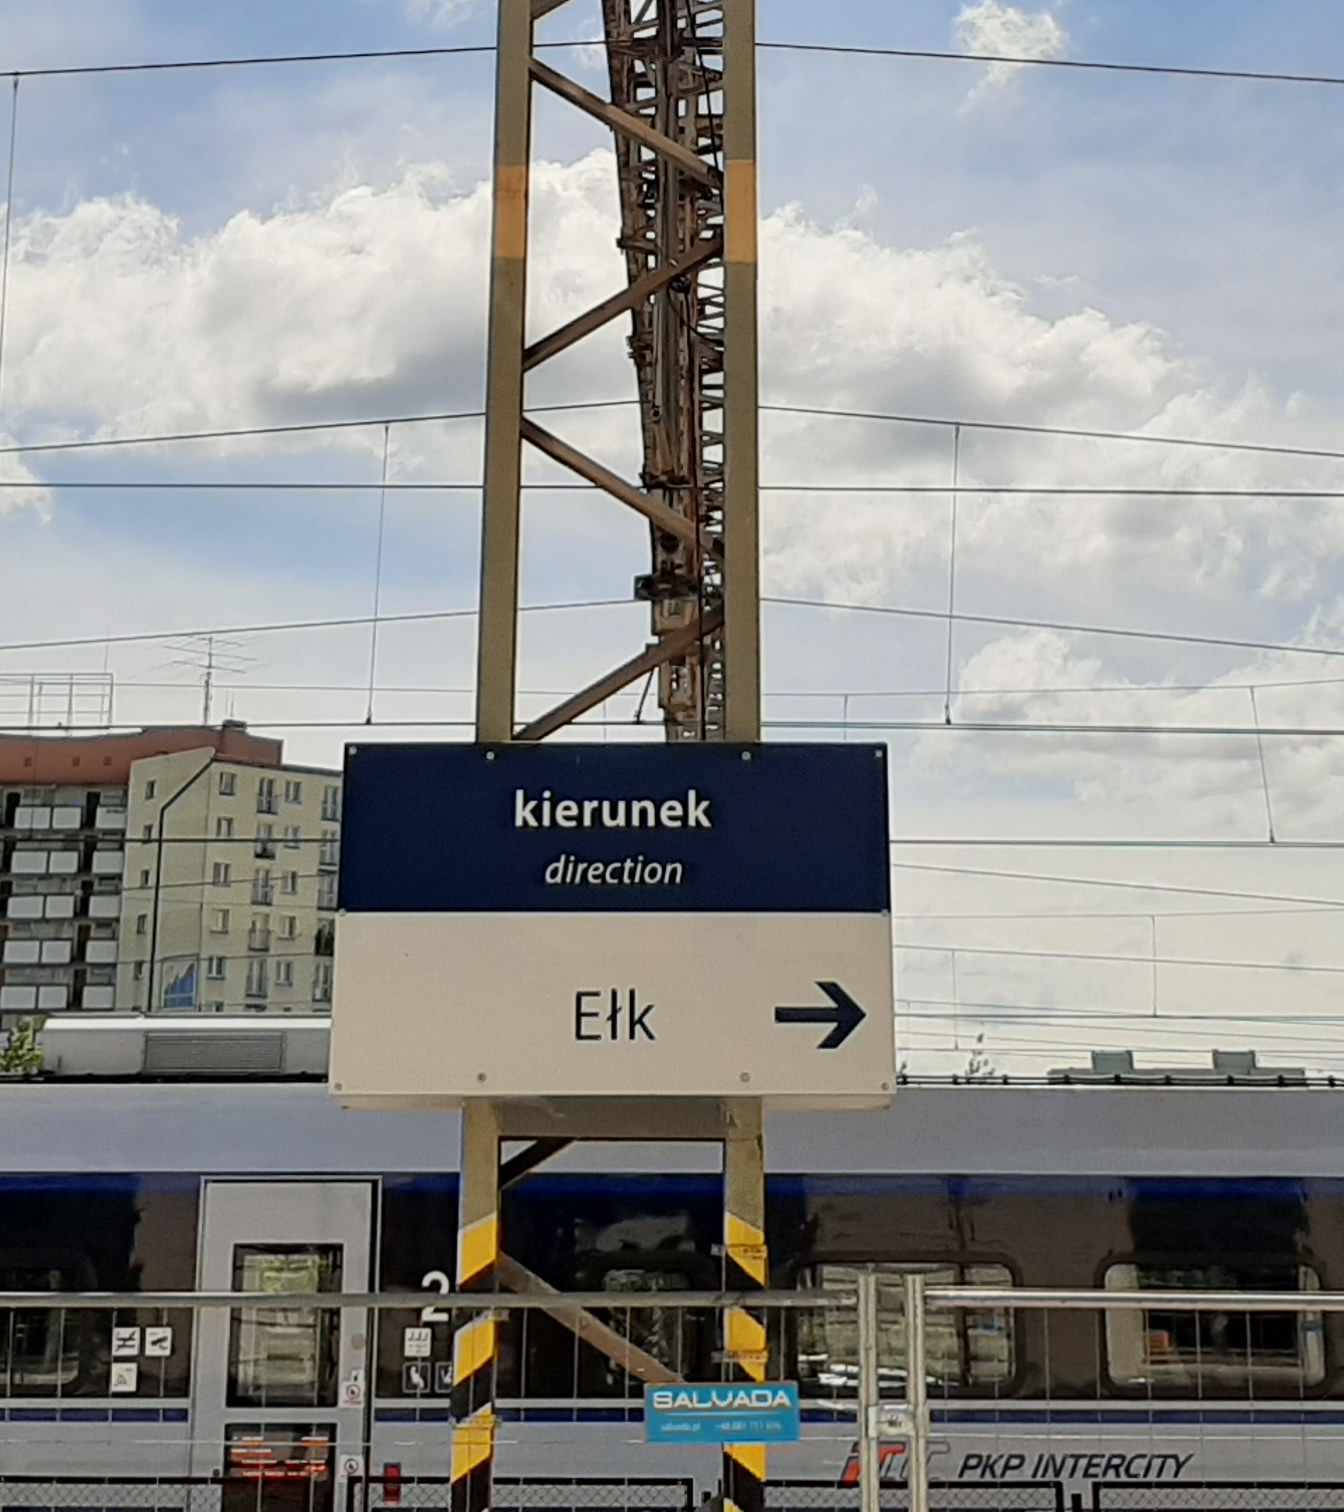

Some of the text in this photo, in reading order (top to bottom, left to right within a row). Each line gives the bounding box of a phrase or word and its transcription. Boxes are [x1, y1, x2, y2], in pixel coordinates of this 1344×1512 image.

[513, 789, 712, 828] kierunek
[544, 854, 684, 885] direction
[574, 988, 656, 1041] Ełk
[422, 1270, 449, 1321] 2
[652, 1389, 792, 1409] SALVADA
[958, 1454, 1025, 1478] PKP
[1031, 1454, 1194, 1479] INTERCITY
